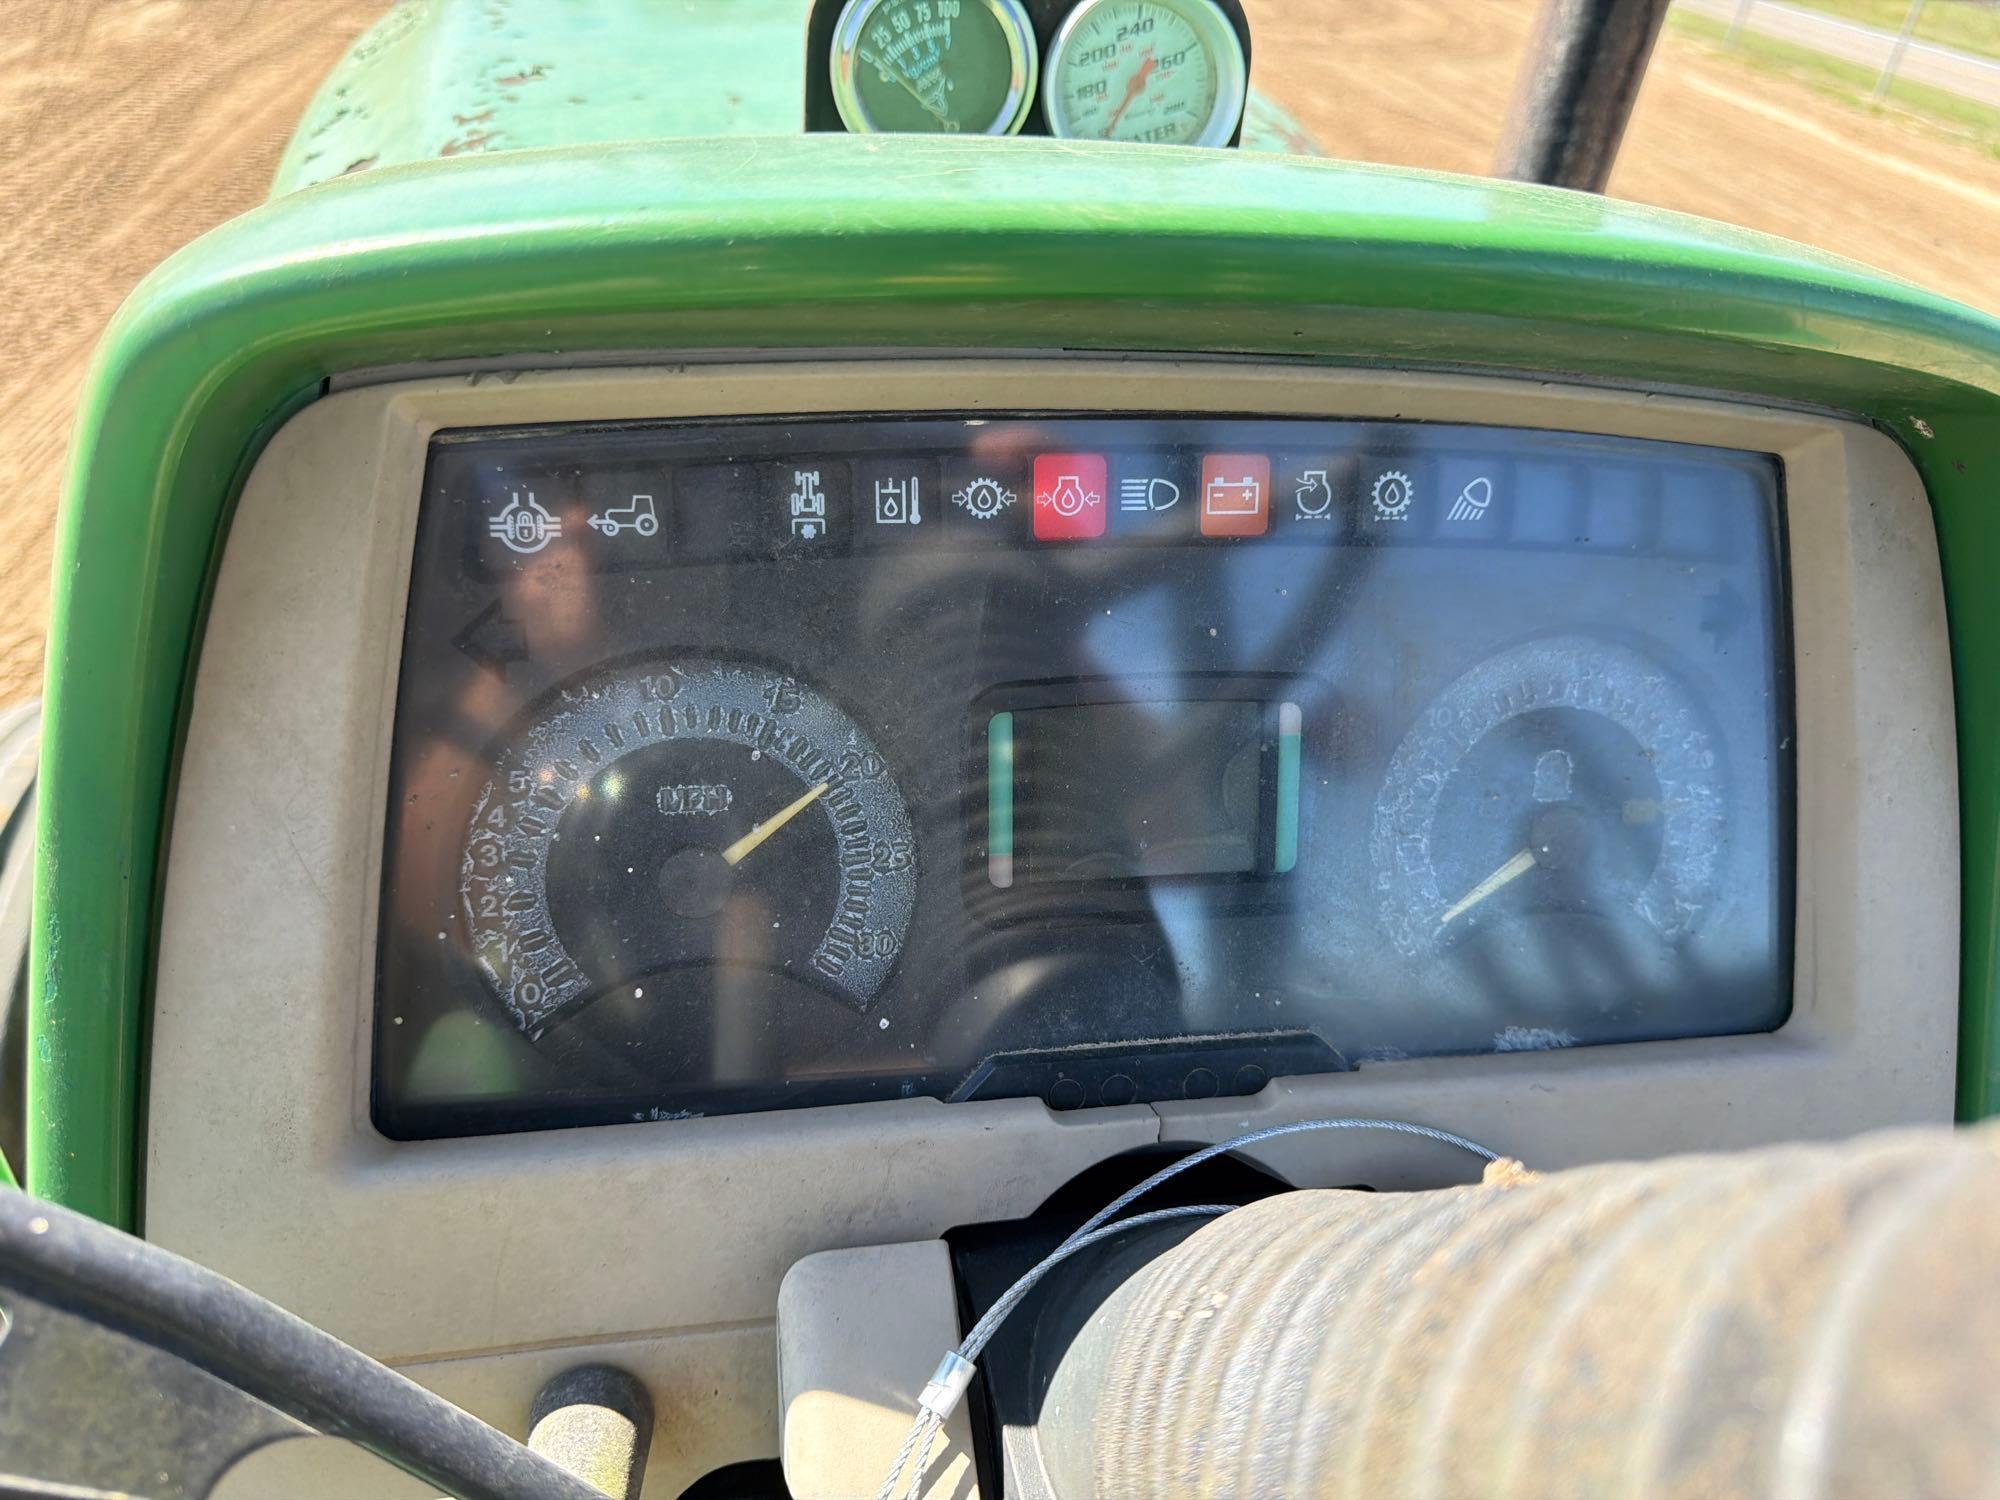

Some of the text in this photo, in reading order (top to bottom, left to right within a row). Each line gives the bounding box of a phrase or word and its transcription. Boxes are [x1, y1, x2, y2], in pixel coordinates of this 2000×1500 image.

[1116, 18, 1154, 42] 240
[1079, 44, 1116, 67] 200
[1077, 80, 1107, 100] 180
[641, 675, 675, 698] 10
[1426, 706, 1451, 727] 10
[509, 771, 529, 793] 5
[488, 805, 508, 828] 4
[480, 844, 499, 868] 3
[873, 841, 912, 871] 25
[480, 895, 499, 918] 2
[858, 931, 896, 956] 30
[521, 983, 541, 1004] 0
